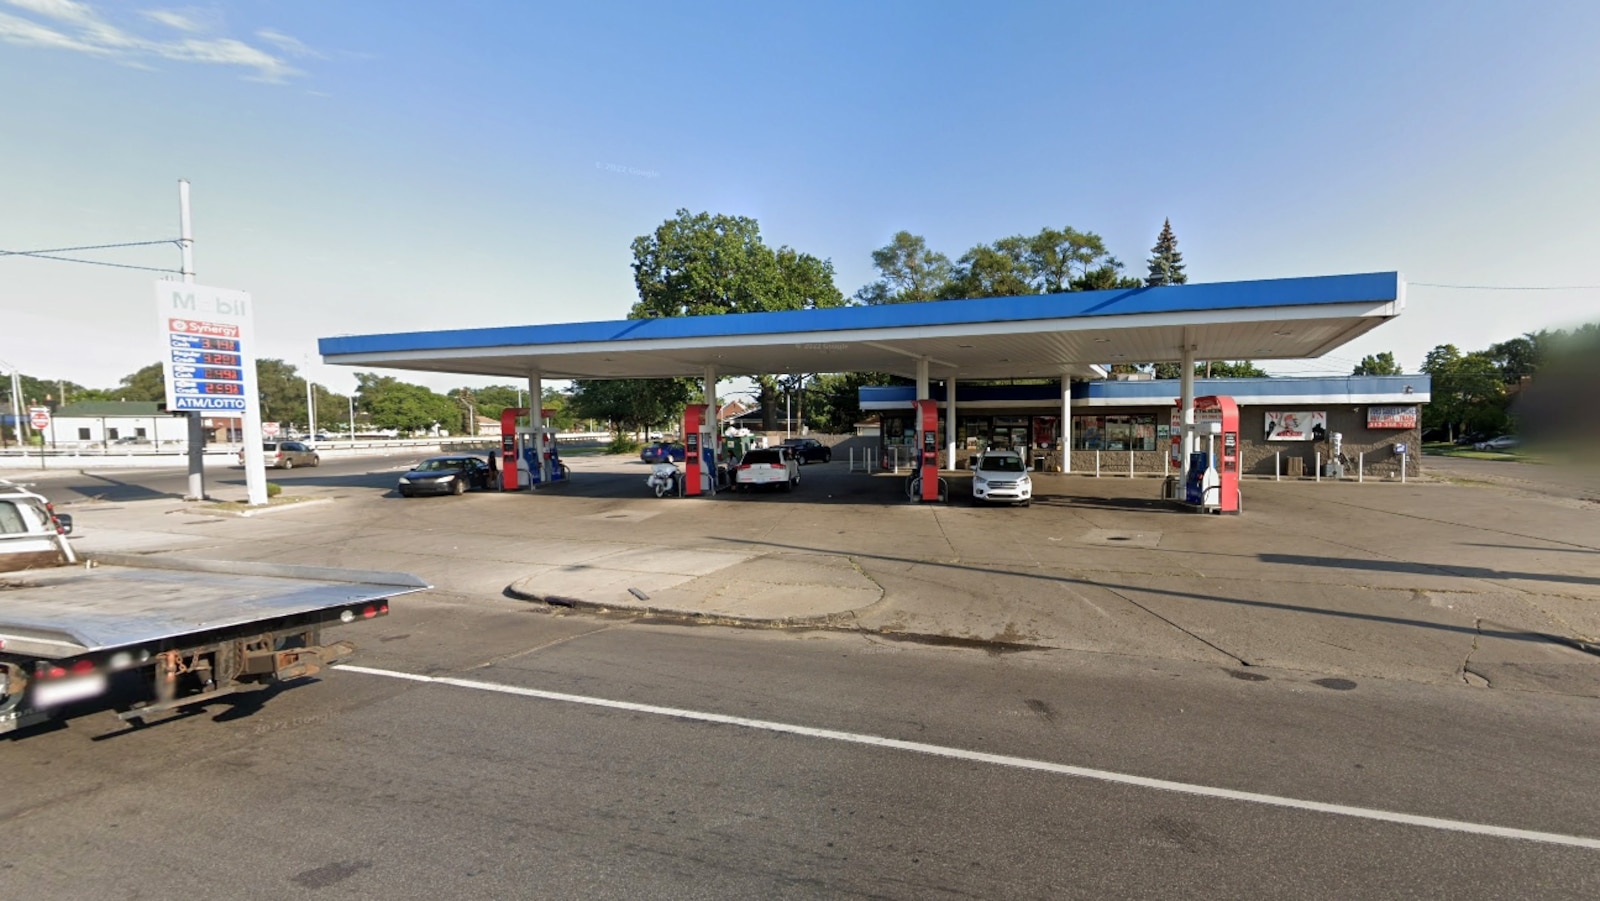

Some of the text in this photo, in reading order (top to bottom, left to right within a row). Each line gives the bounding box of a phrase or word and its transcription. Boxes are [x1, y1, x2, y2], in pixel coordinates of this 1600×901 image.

[172, 291, 246, 316] Mbil
[188, 321, 238, 337] Synergy
[177, 398, 246, 409] ATM/LOTTO
